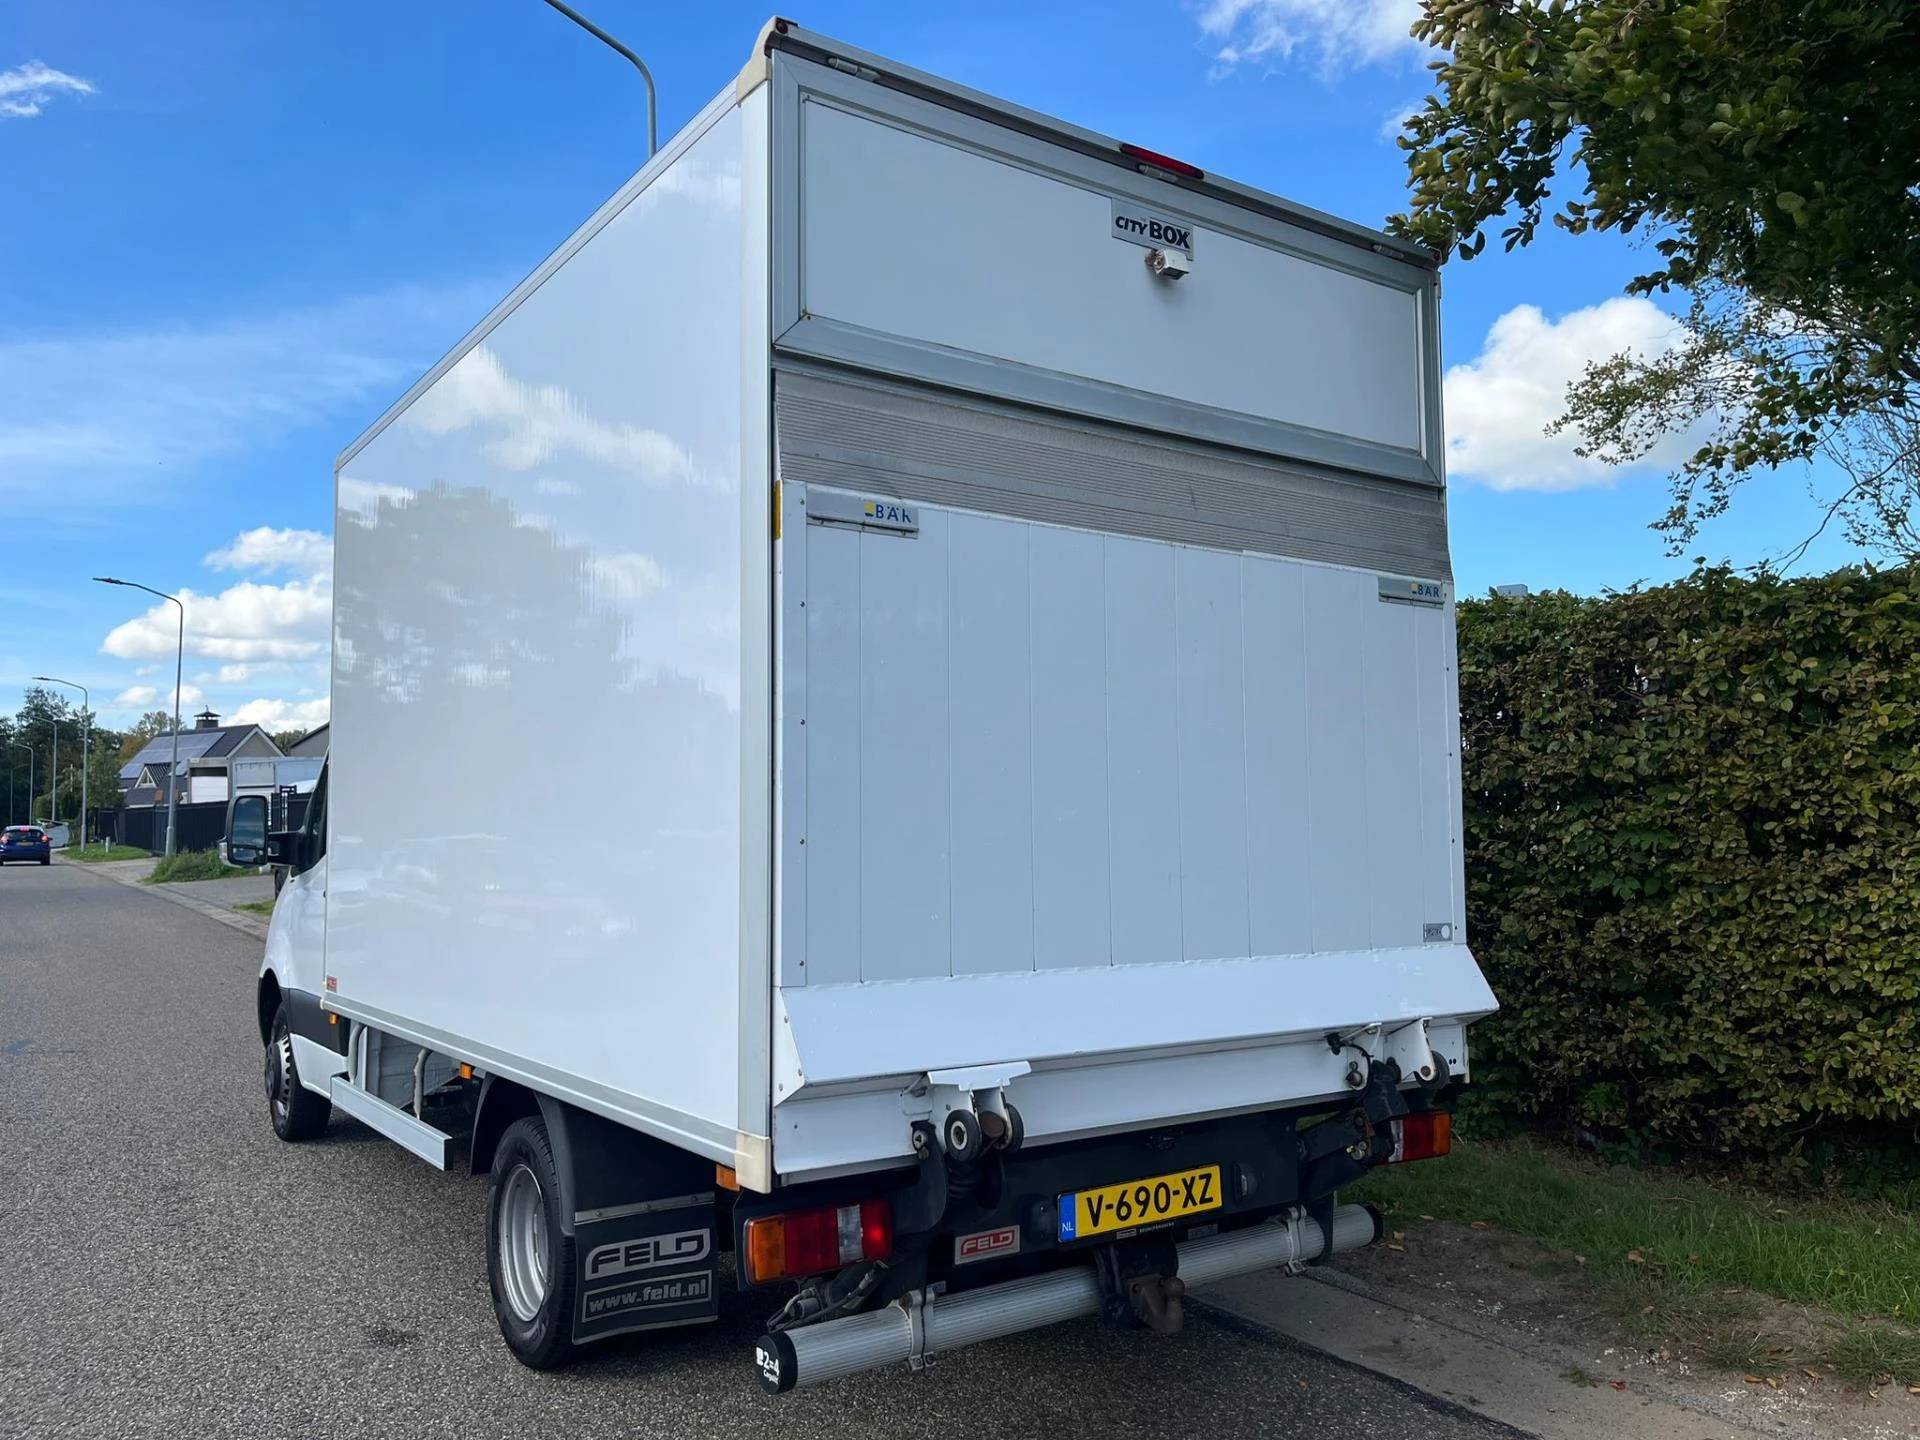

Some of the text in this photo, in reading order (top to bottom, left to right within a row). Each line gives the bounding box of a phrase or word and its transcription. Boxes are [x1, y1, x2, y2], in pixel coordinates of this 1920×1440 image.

[1115, 215, 1191, 249] CITY BOX
[1417, 583, 1440, 598] BÄR
[1085, 1172, 1215, 1228] V-690-XZ
[962, 1231, 1013, 1254] FELD
[1061, 1221, 1075, 1232] NL
[590, 1233, 705, 1275] FELD
[588, 1279, 707, 1313] www.feld.nl
